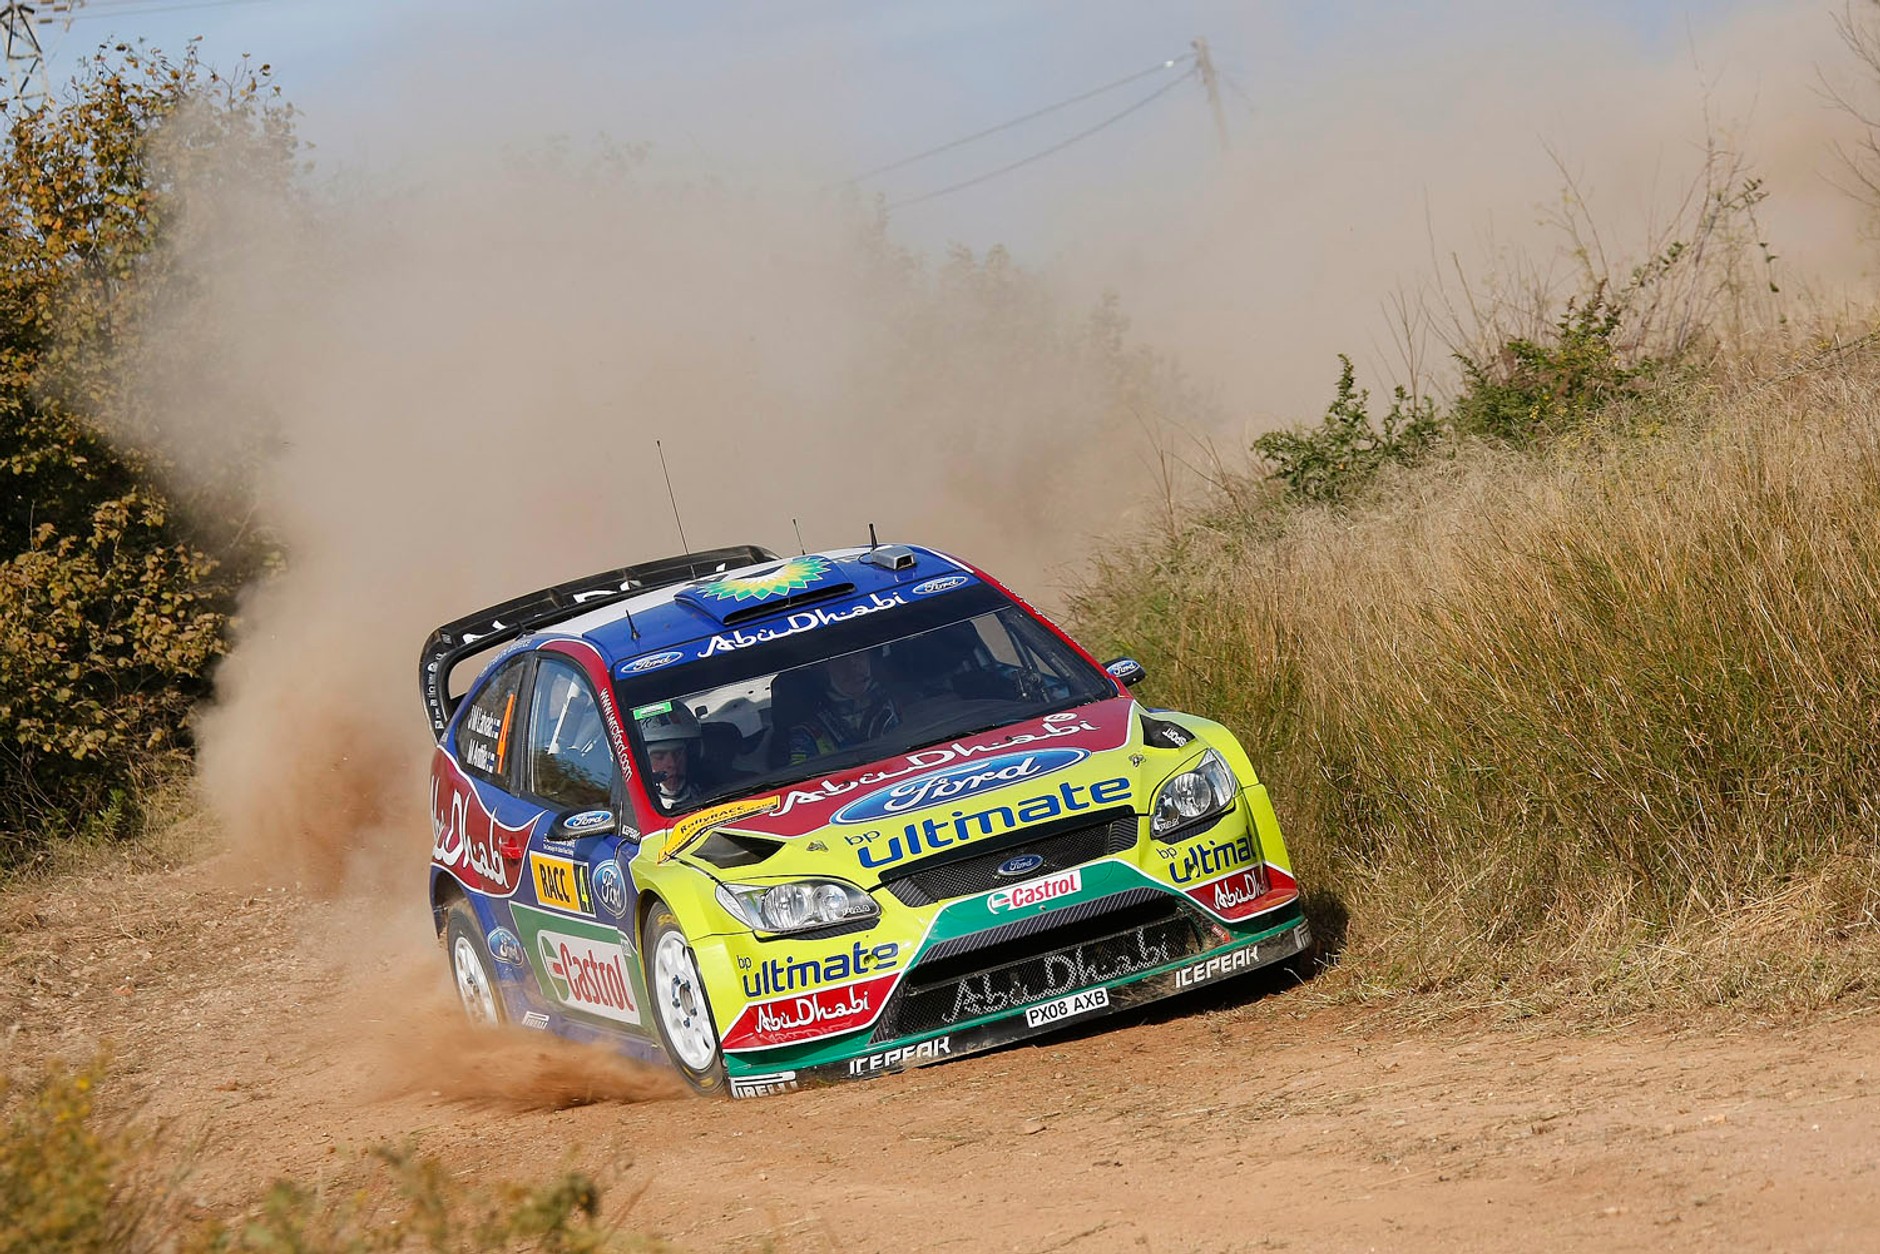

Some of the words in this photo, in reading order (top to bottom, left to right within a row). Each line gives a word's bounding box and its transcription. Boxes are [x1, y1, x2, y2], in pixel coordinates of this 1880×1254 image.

[924, 578, 958, 593] Ford
[633, 654, 673, 671] Ford
[1112, 660, 1138, 676] Ford
[1162, 727, 1188, 747] SPORT
[883, 756, 1042, 812] Ford
[572, 811, 604, 827] Ford
[857, 776, 1132, 869] ultimate
[843, 830, 880, 846] bp
[1156, 846, 1178, 860] bp
[1008, 857, 1034, 871] Ford
[539, 863, 571, 903] RACC
[579, 865, 590, 912] 4
[1012, 874, 1077, 907] Castrol
[737, 955, 752, 970] bp
[743, 940, 898, 998] ultimate
[1175, 944, 1259, 989] ICEPEAK
[560, 942, 635, 1012] Castrol
[1028, 1000, 1068, 1026] PX08
[1073, 989, 1106, 1013] AXB
